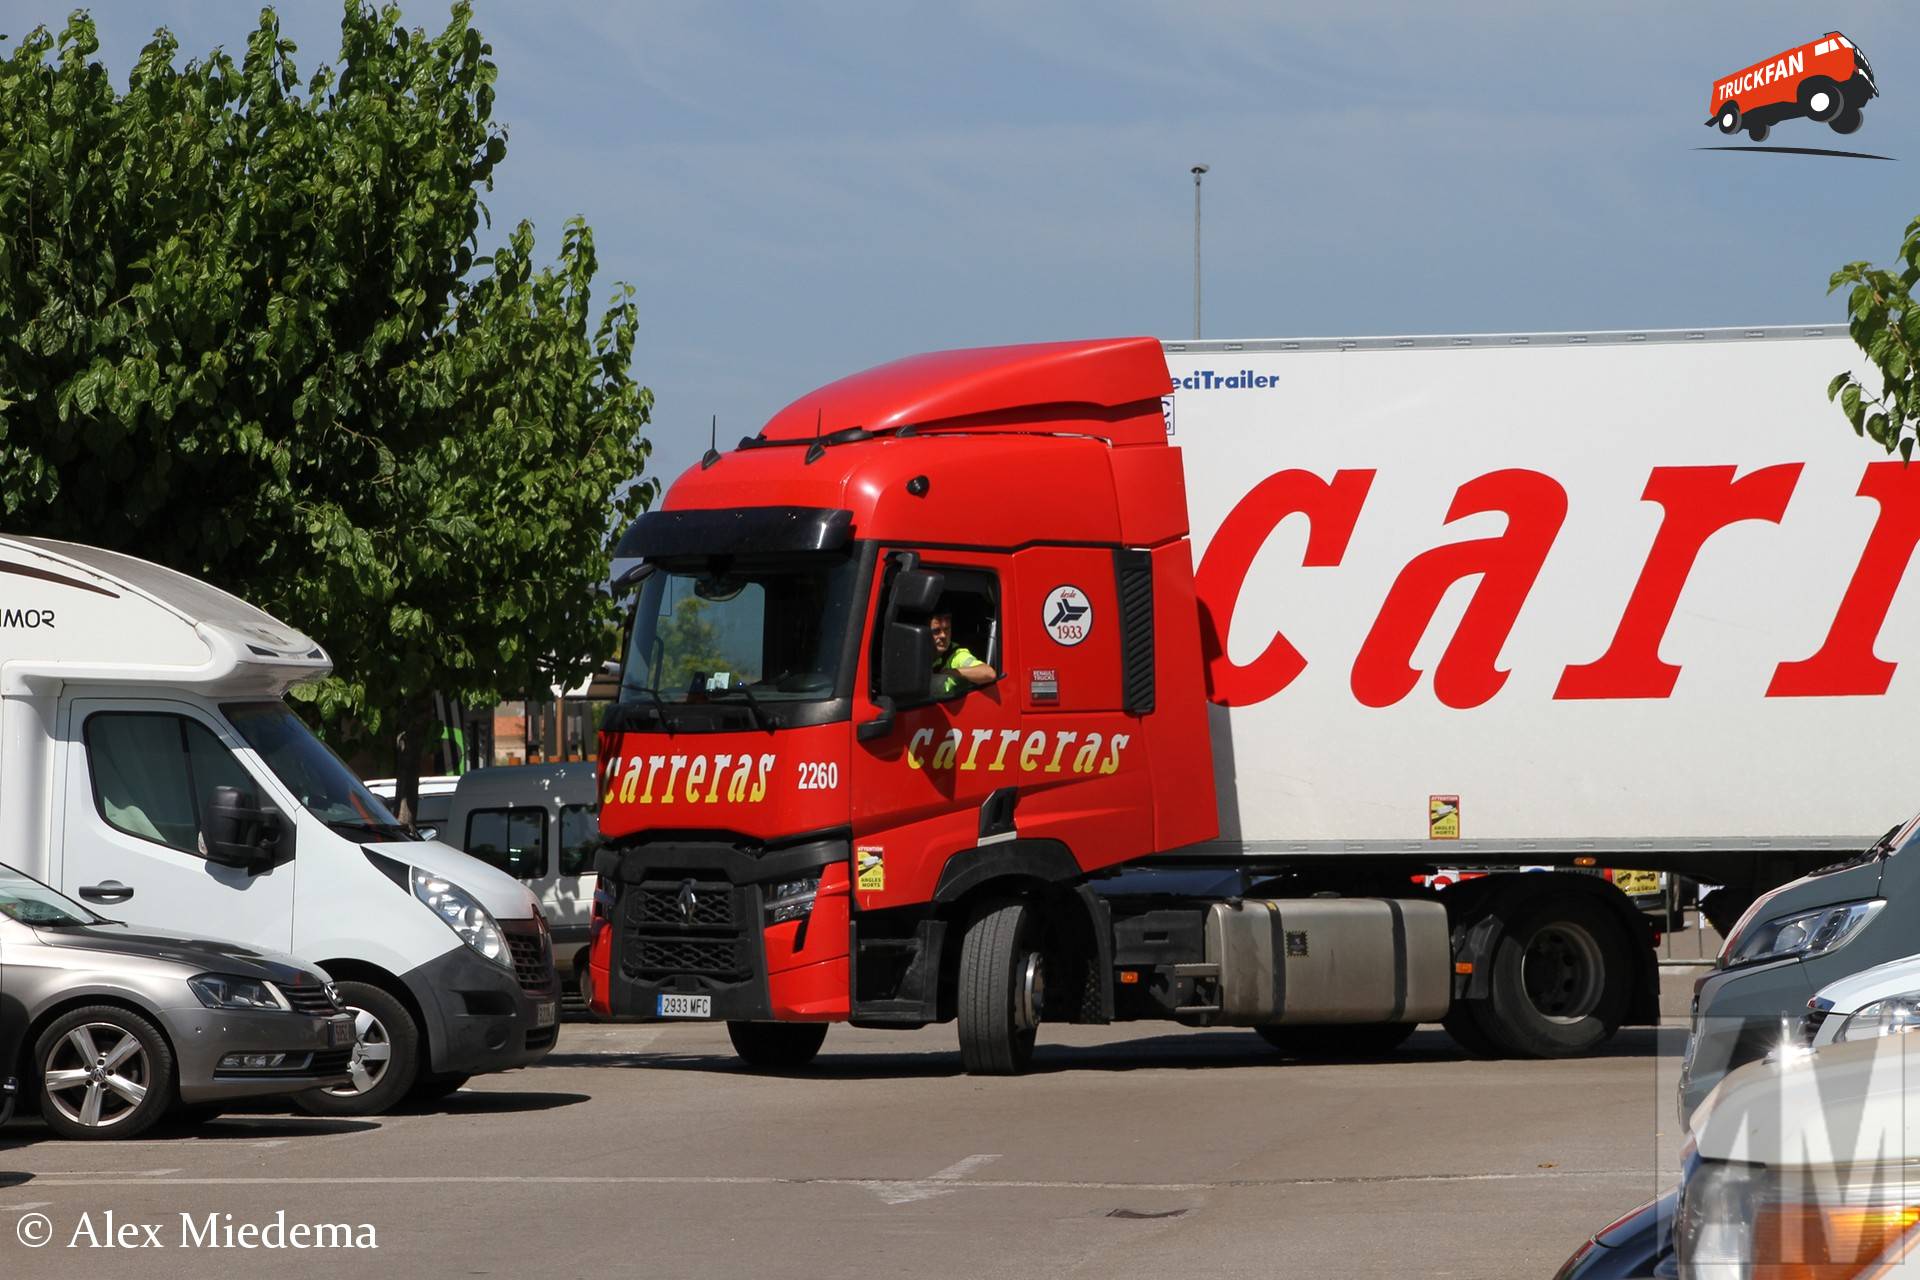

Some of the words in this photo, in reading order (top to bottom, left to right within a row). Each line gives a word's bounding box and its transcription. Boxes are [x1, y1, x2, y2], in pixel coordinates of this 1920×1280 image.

[1057, 625, 1083, 639] 1933
[907, 727, 1130, 774] carreras
[604, 753, 776, 804] carreras
[798, 762, 838, 789] 2260
[664, 998, 688, 1013] 2933
[690, 999, 708, 1013] MFC
